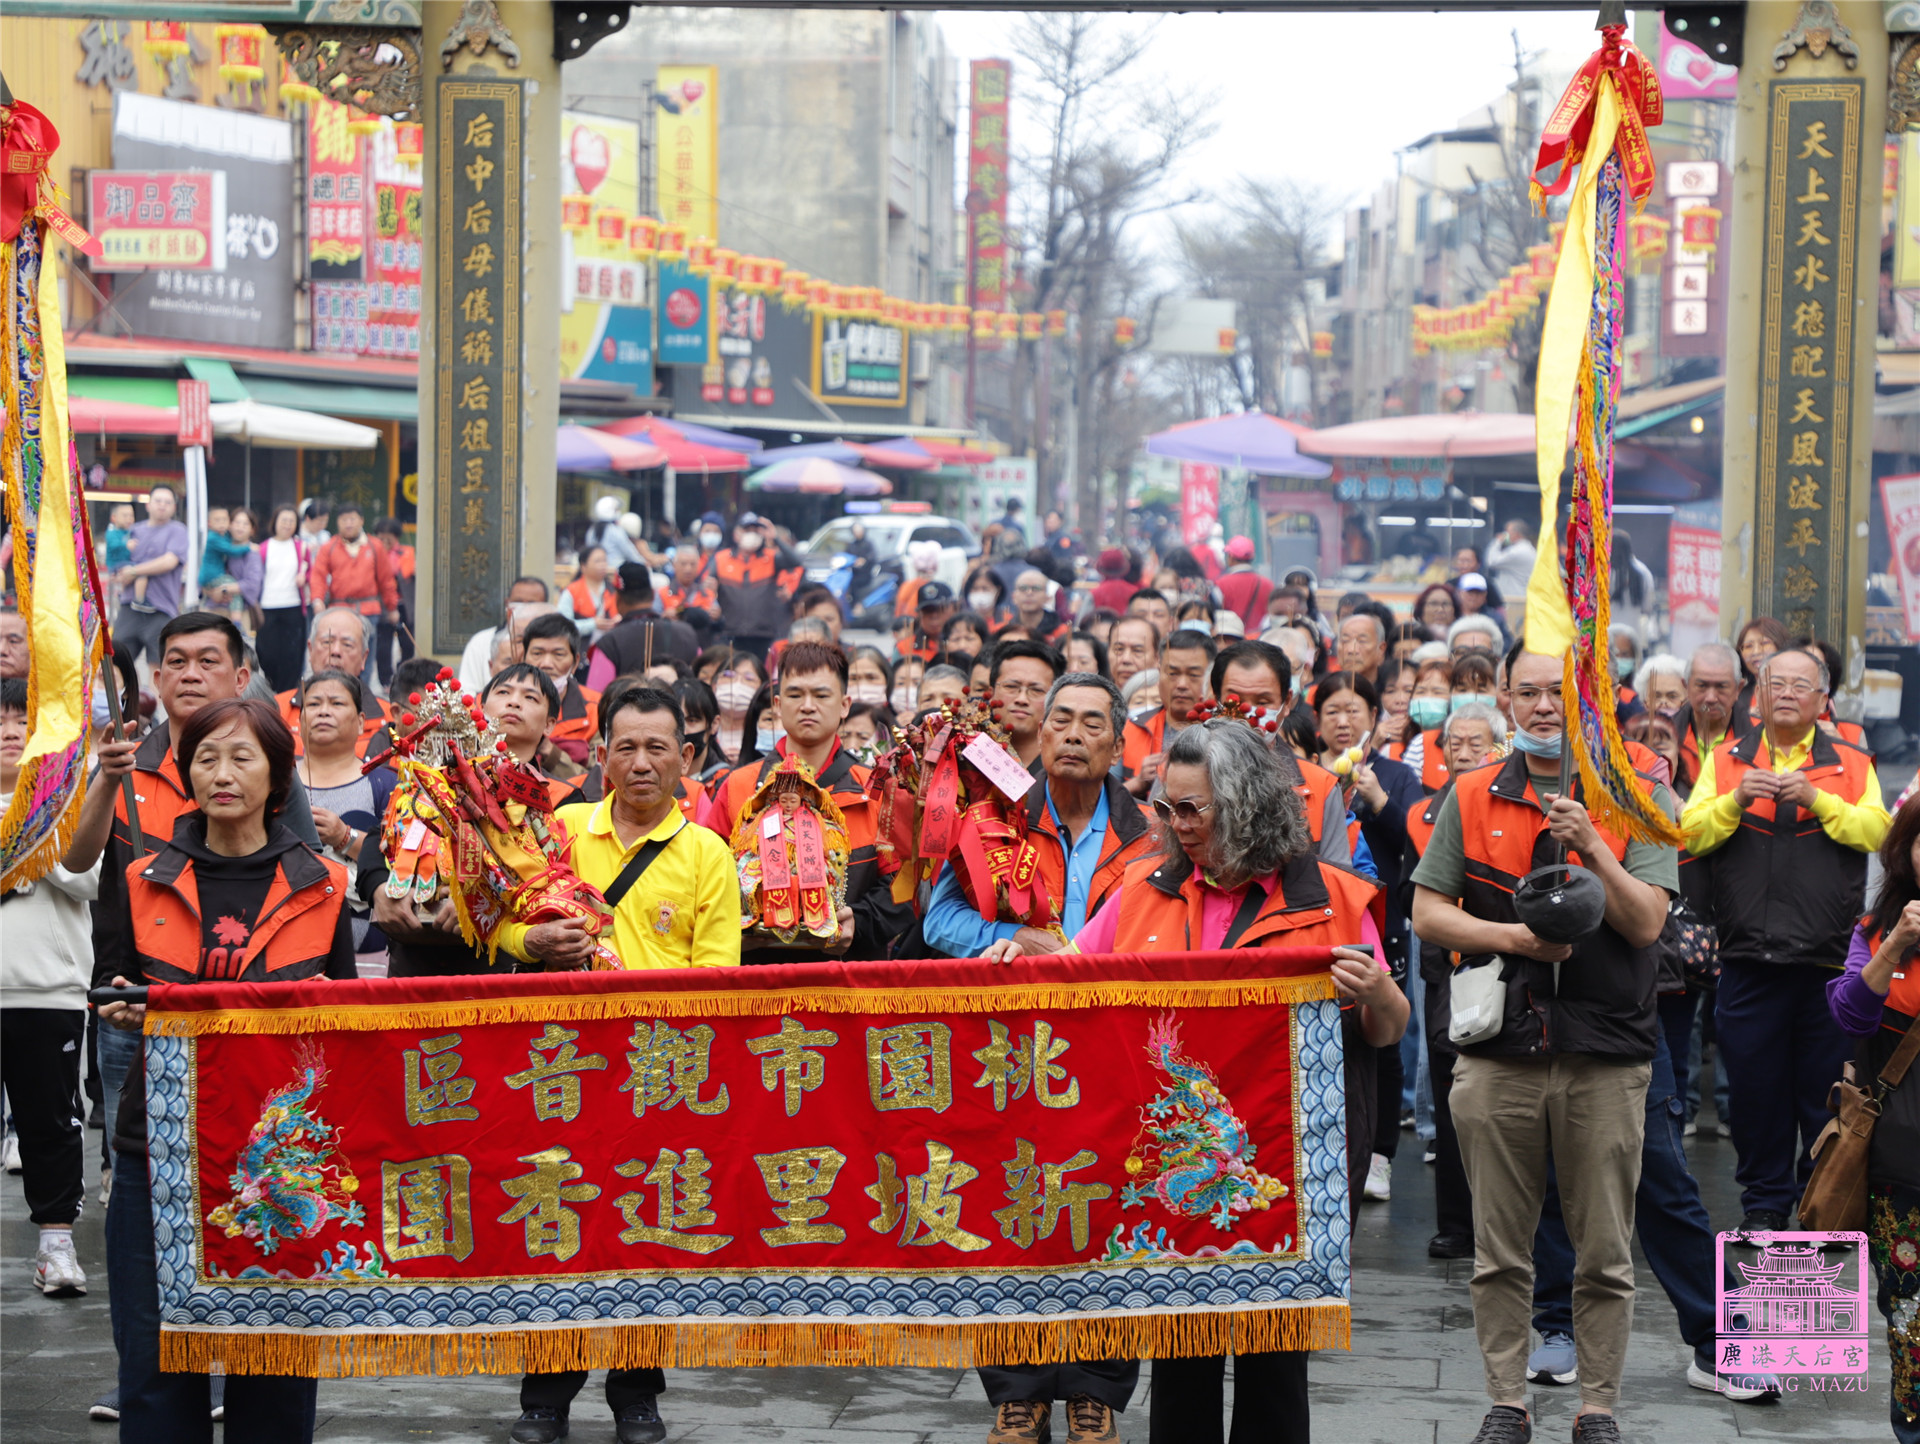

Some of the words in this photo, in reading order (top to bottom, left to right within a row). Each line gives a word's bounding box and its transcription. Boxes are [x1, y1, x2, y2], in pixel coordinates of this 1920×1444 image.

[402, 1015, 1081, 1127] 桃園市觀音區
[379, 1137, 1113, 1263] 新坡里進香團
